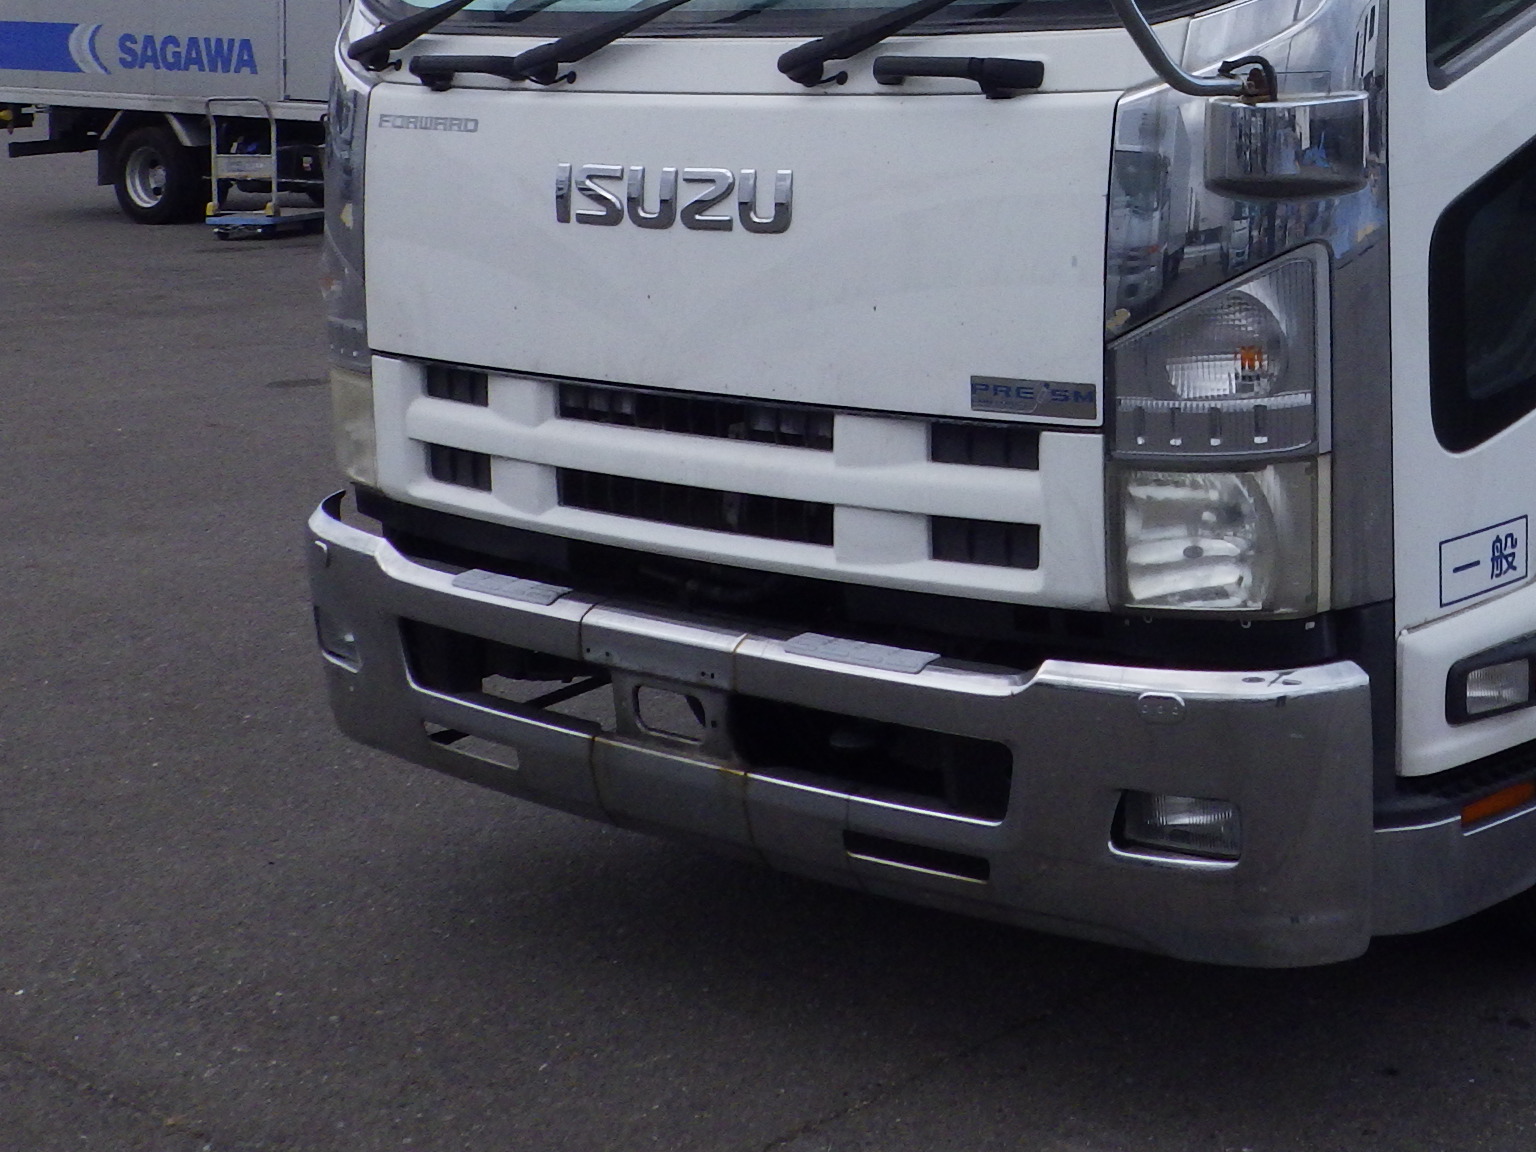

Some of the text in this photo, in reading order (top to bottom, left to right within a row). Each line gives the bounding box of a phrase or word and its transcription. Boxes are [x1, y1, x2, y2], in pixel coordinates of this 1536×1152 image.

[118, 33, 258, 75] SAGAWA
[379, 113, 479, 133] FORWARD
[555, 162, 793, 235] ISUZU
[1452, 532, 1518, 580] 一般
